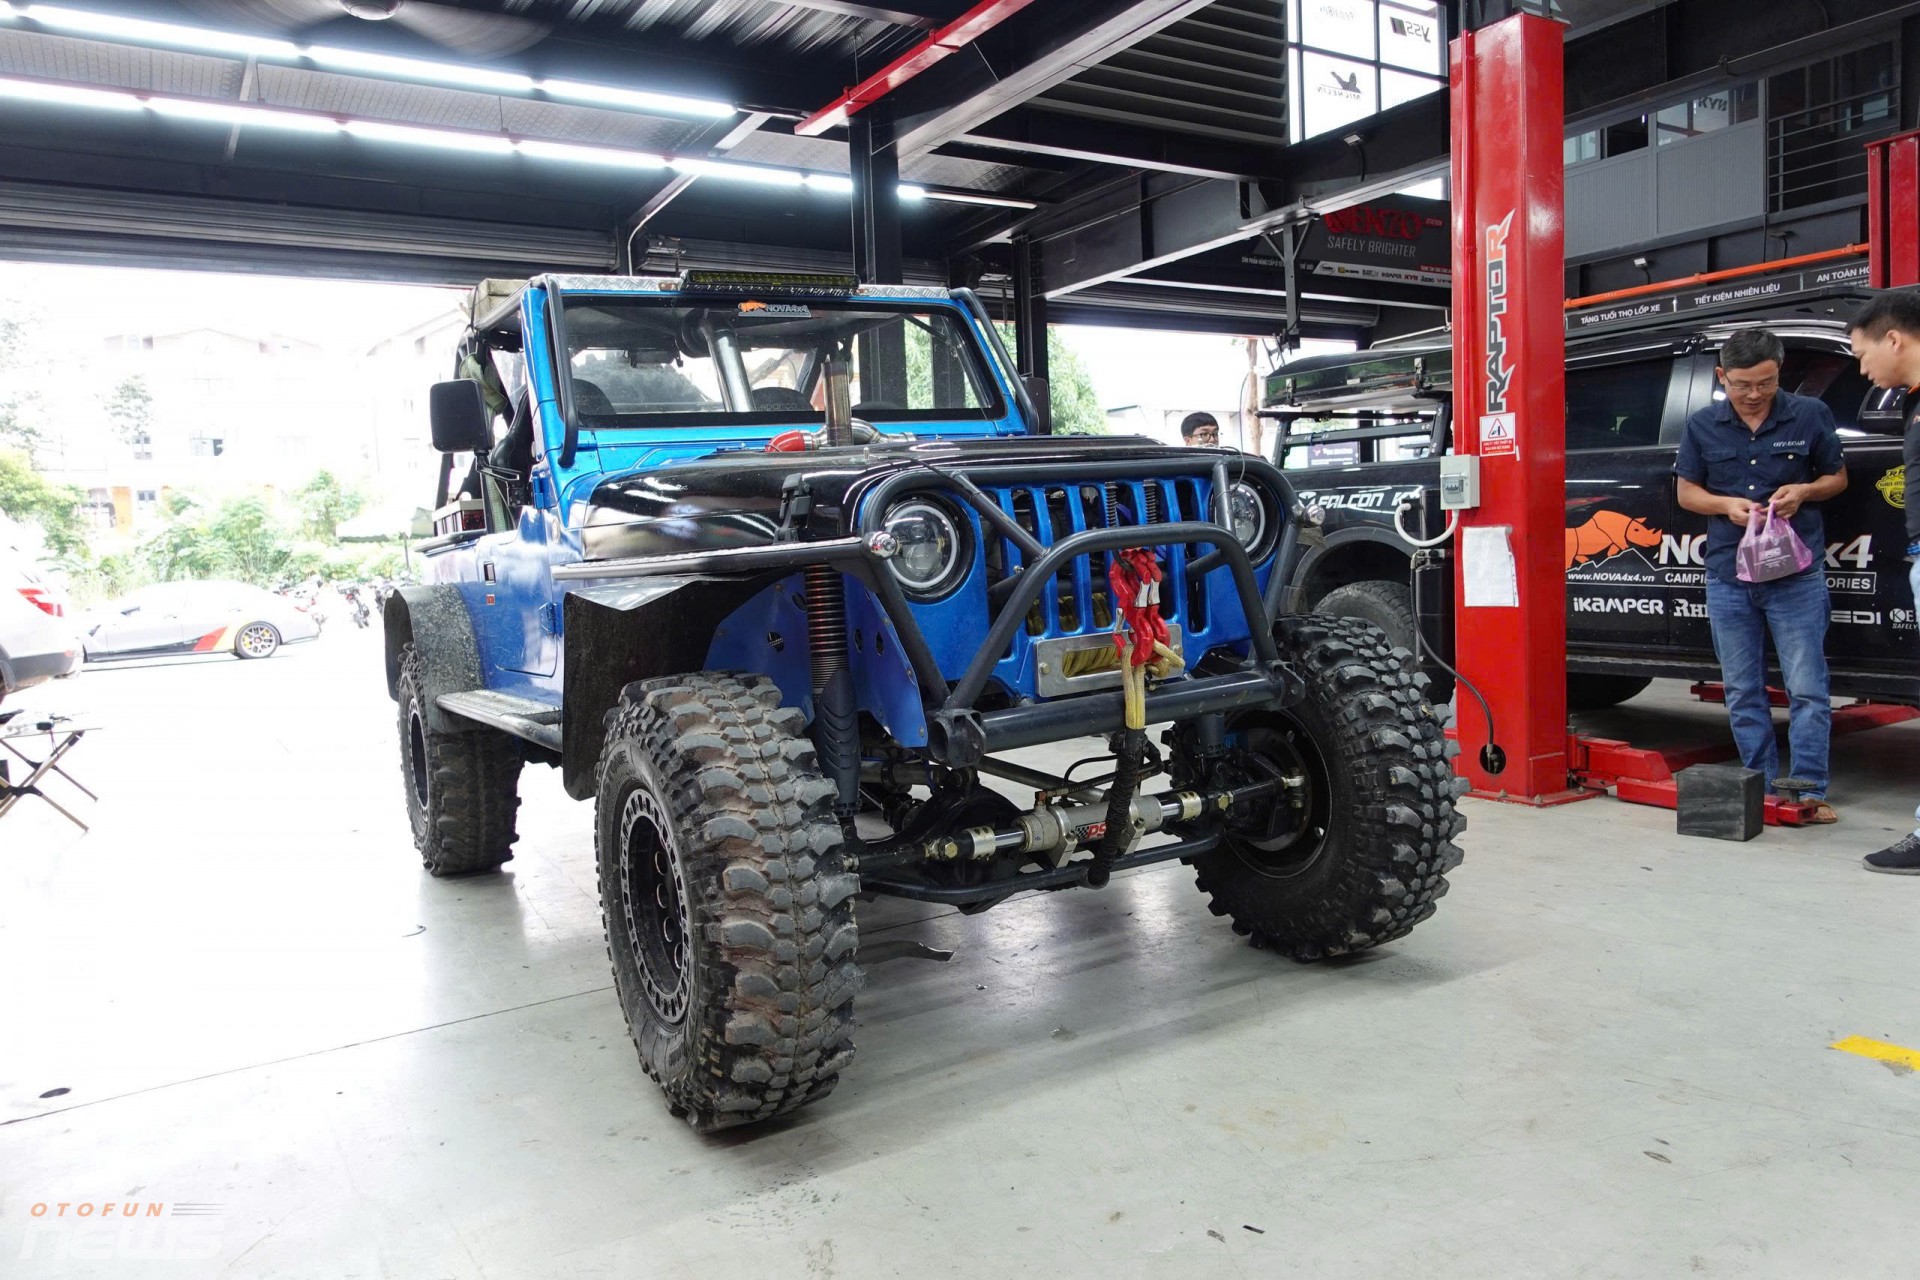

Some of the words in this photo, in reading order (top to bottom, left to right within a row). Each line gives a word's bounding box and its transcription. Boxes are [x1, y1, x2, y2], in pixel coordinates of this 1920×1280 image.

[1327, 235, 1366, 252] SAFELY
[1368, 240, 1417, 258] BRIGHTER
[1816, 273, 1830, 284] AN
[1831, 268, 1857, 280] TOÀN
[1734, 286, 1760, 299] NHIÊN
[1485, 208, 1516, 414] RAPTOR
[1580, 314, 1600, 325] TĂNG
[1650, 303, 1661, 313] XE
[1319, 492, 1385, 509] FALCON
[1567, 572, 1655, 583] www.NOVA4x4.vn
[1825, 577, 1871, 590] ORIES
[1830, 610, 1882, 625] EDI
[1889, 608, 1914, 623] KE
